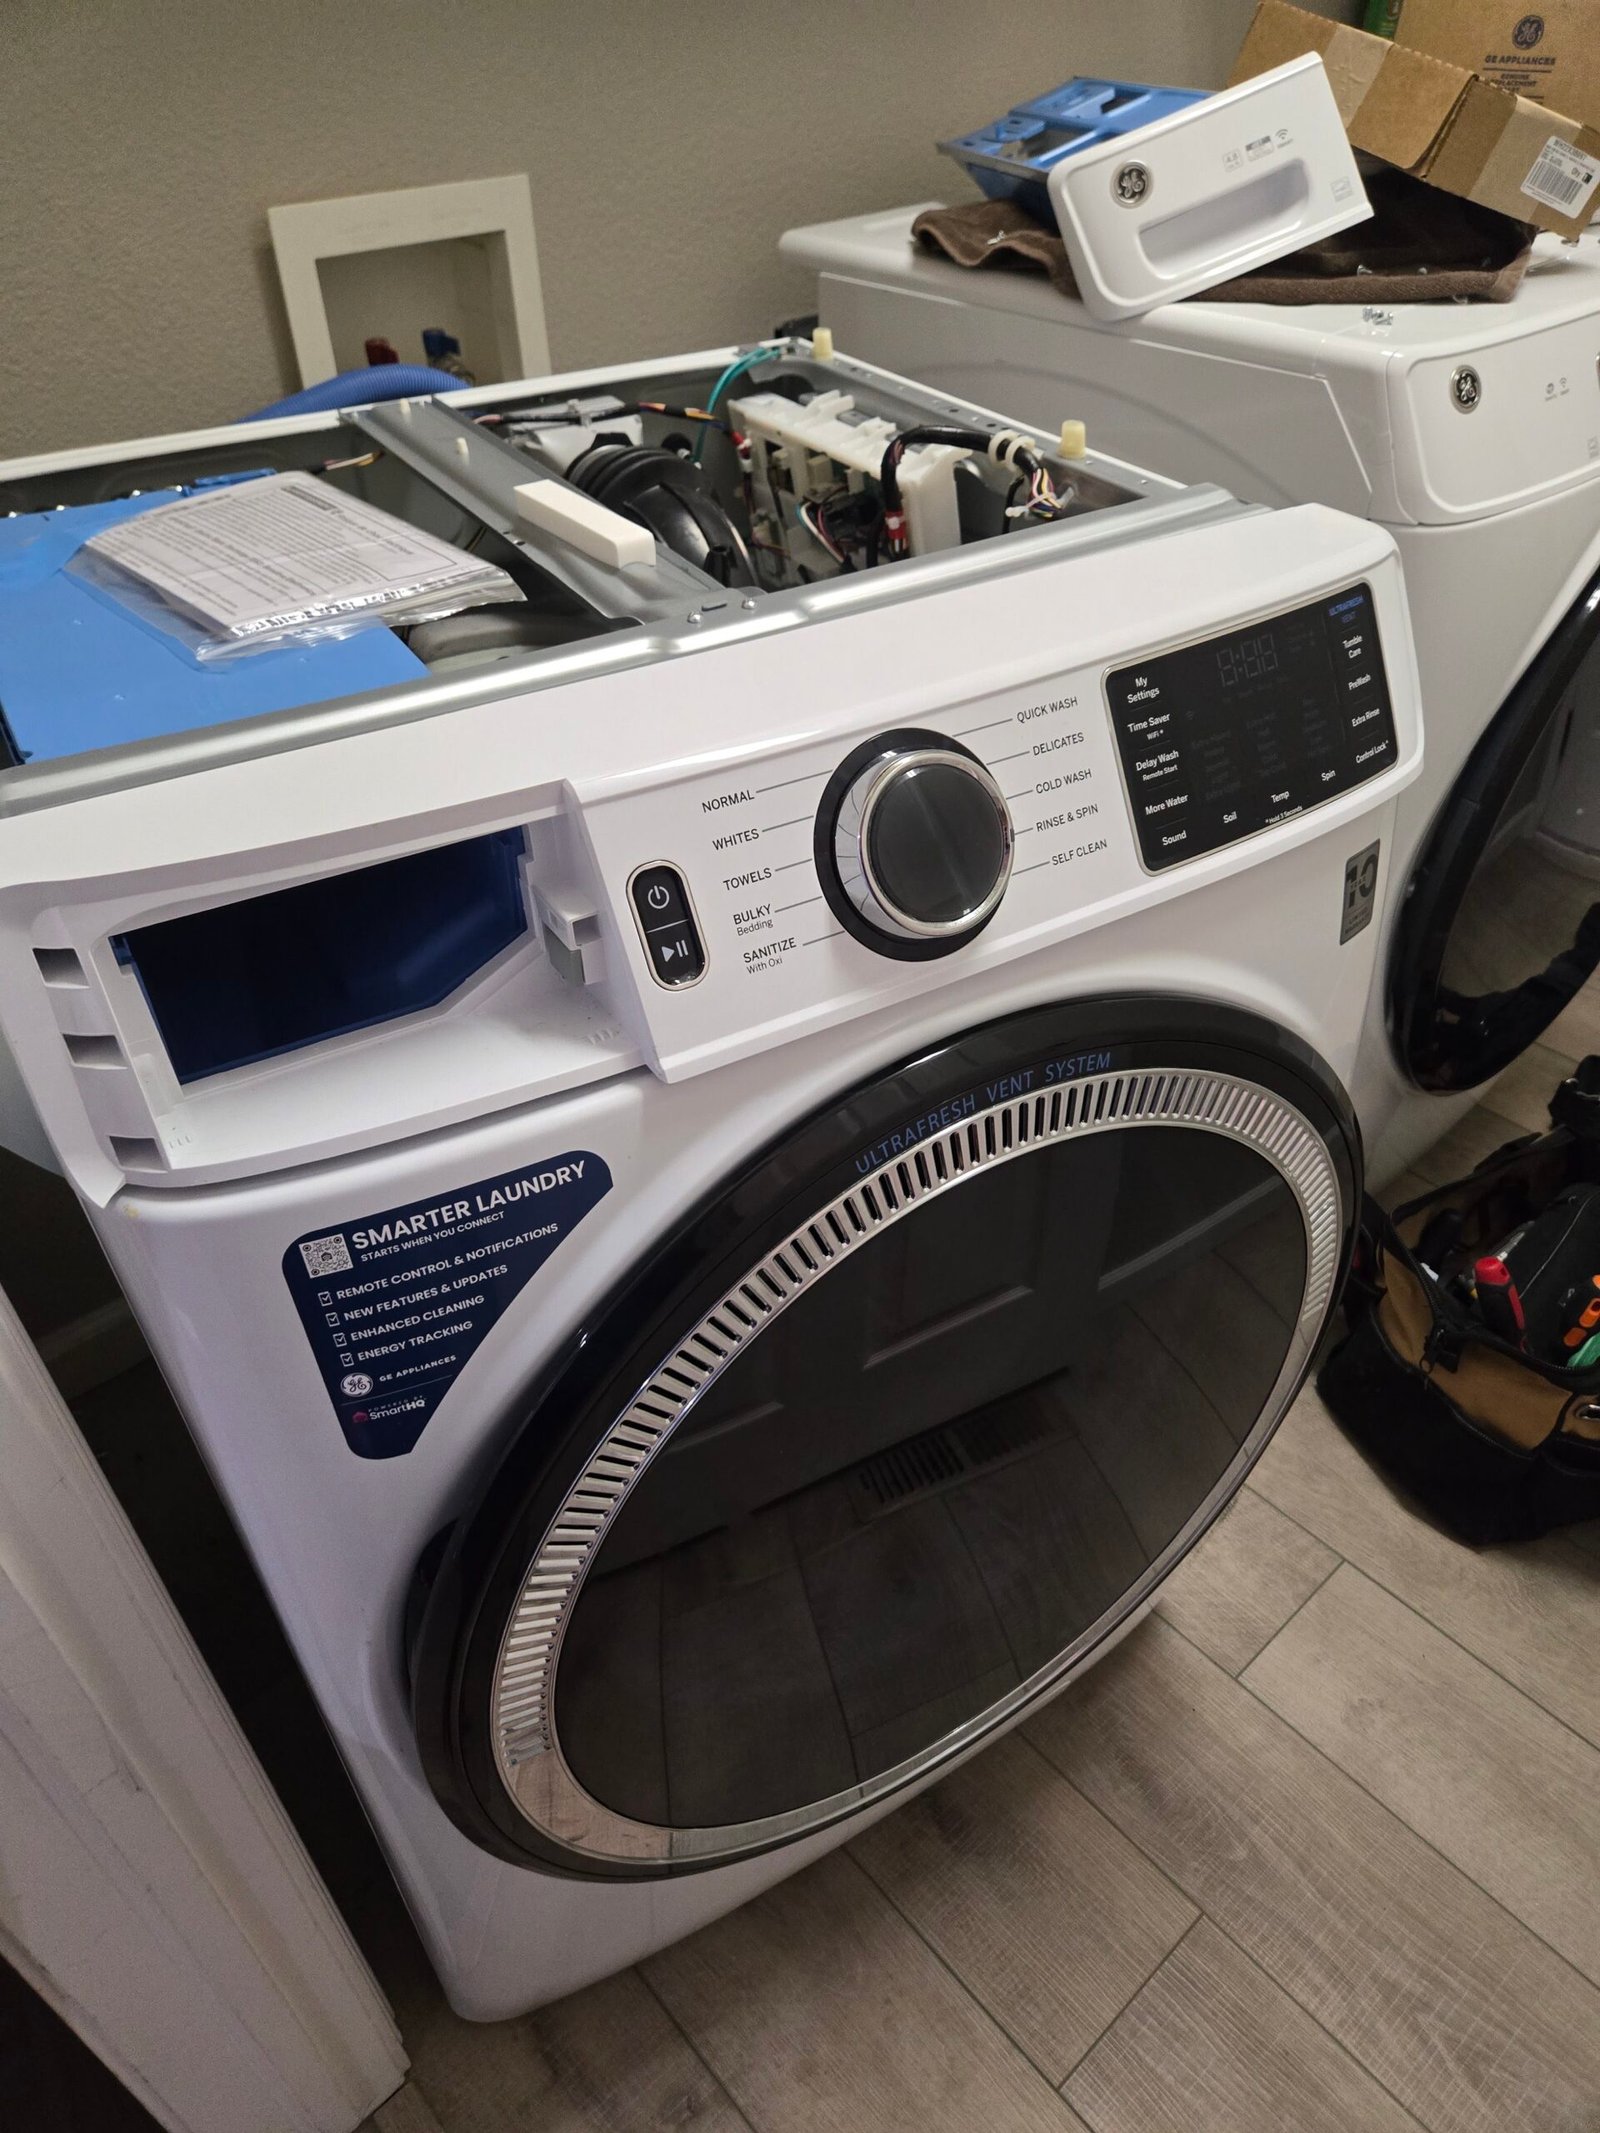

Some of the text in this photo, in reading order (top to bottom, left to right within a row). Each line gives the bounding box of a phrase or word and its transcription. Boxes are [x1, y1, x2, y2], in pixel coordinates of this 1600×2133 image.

[1484, 55, 1556, 65] GE APPLIANCES
[1342, 635, 1363, 649] Tumble
[1348, 648, 1362, 659] Care
[1135, 676, 1148, 687] My
[1348, 674, 1371, 690] PreWash
[1127, 687, 1160, 704] Settings
[1017, 696, 1078, 723] QUICK WASH
[1352, 708, 1380, 727] Extra Rinse
[1127, 713, 1170, 733] Time Saver
[1032, 732, 1084, 756] DELICATES
[1136, 750, 1179, 771] Delay Wash
[1356, 748, 1374, 764] Control
[1036, 768, 1092, 794] COLD WASH
[1142, 764, 1178, 781] Remote Start
[1321, 770, 1336, 781] Spin
[702, 790, 755, 814] NORMAL
[1145, 794, 1188, 815] More Water
[1271, 790, 1290, 803] Temp
[1036, 804, 1099, 832] RINSE & SPIN
[1223, 811, 1238, 824] Soil
[1284, 805, 1303, 818] Seconds
[712, 828, 760, 851] WHITES
[1162, 830, 1187, 846] Sound
[1052, 838, 1108, 866] SELF CLEAN
[723, 868, 772, 891] TOWELS
[733, 904, 772, 925] BULKY
[736, 918, 774, 936] Bedding
[743, 937, 797, 964] SANITIZE
[746, 956, 783, 974] With Oxi
[855, 1052, 1112, 1174] ULTRAFRESH VENT SYSTEM
[352, 1160, 586, 1250] SMARTER LAUNDRY
[360, 1210, 505, 1262] STARTS WHEN YOU CONNECT
[336, 1222, 559, 1300] REMOTE CONTROL & NOTIFICATIONS
[344, 1264, 508, 1321] NEW FEATURES & UPDATES
[350, 1294, 485, 1342] ENHANCED CLEANING
[358, 1320, 474, 1361] ENERGY TRACKING
[379, 1355, 457, 1382] GE APPLIANCES
[369, 1398, 426, 1420] SmartHQ
